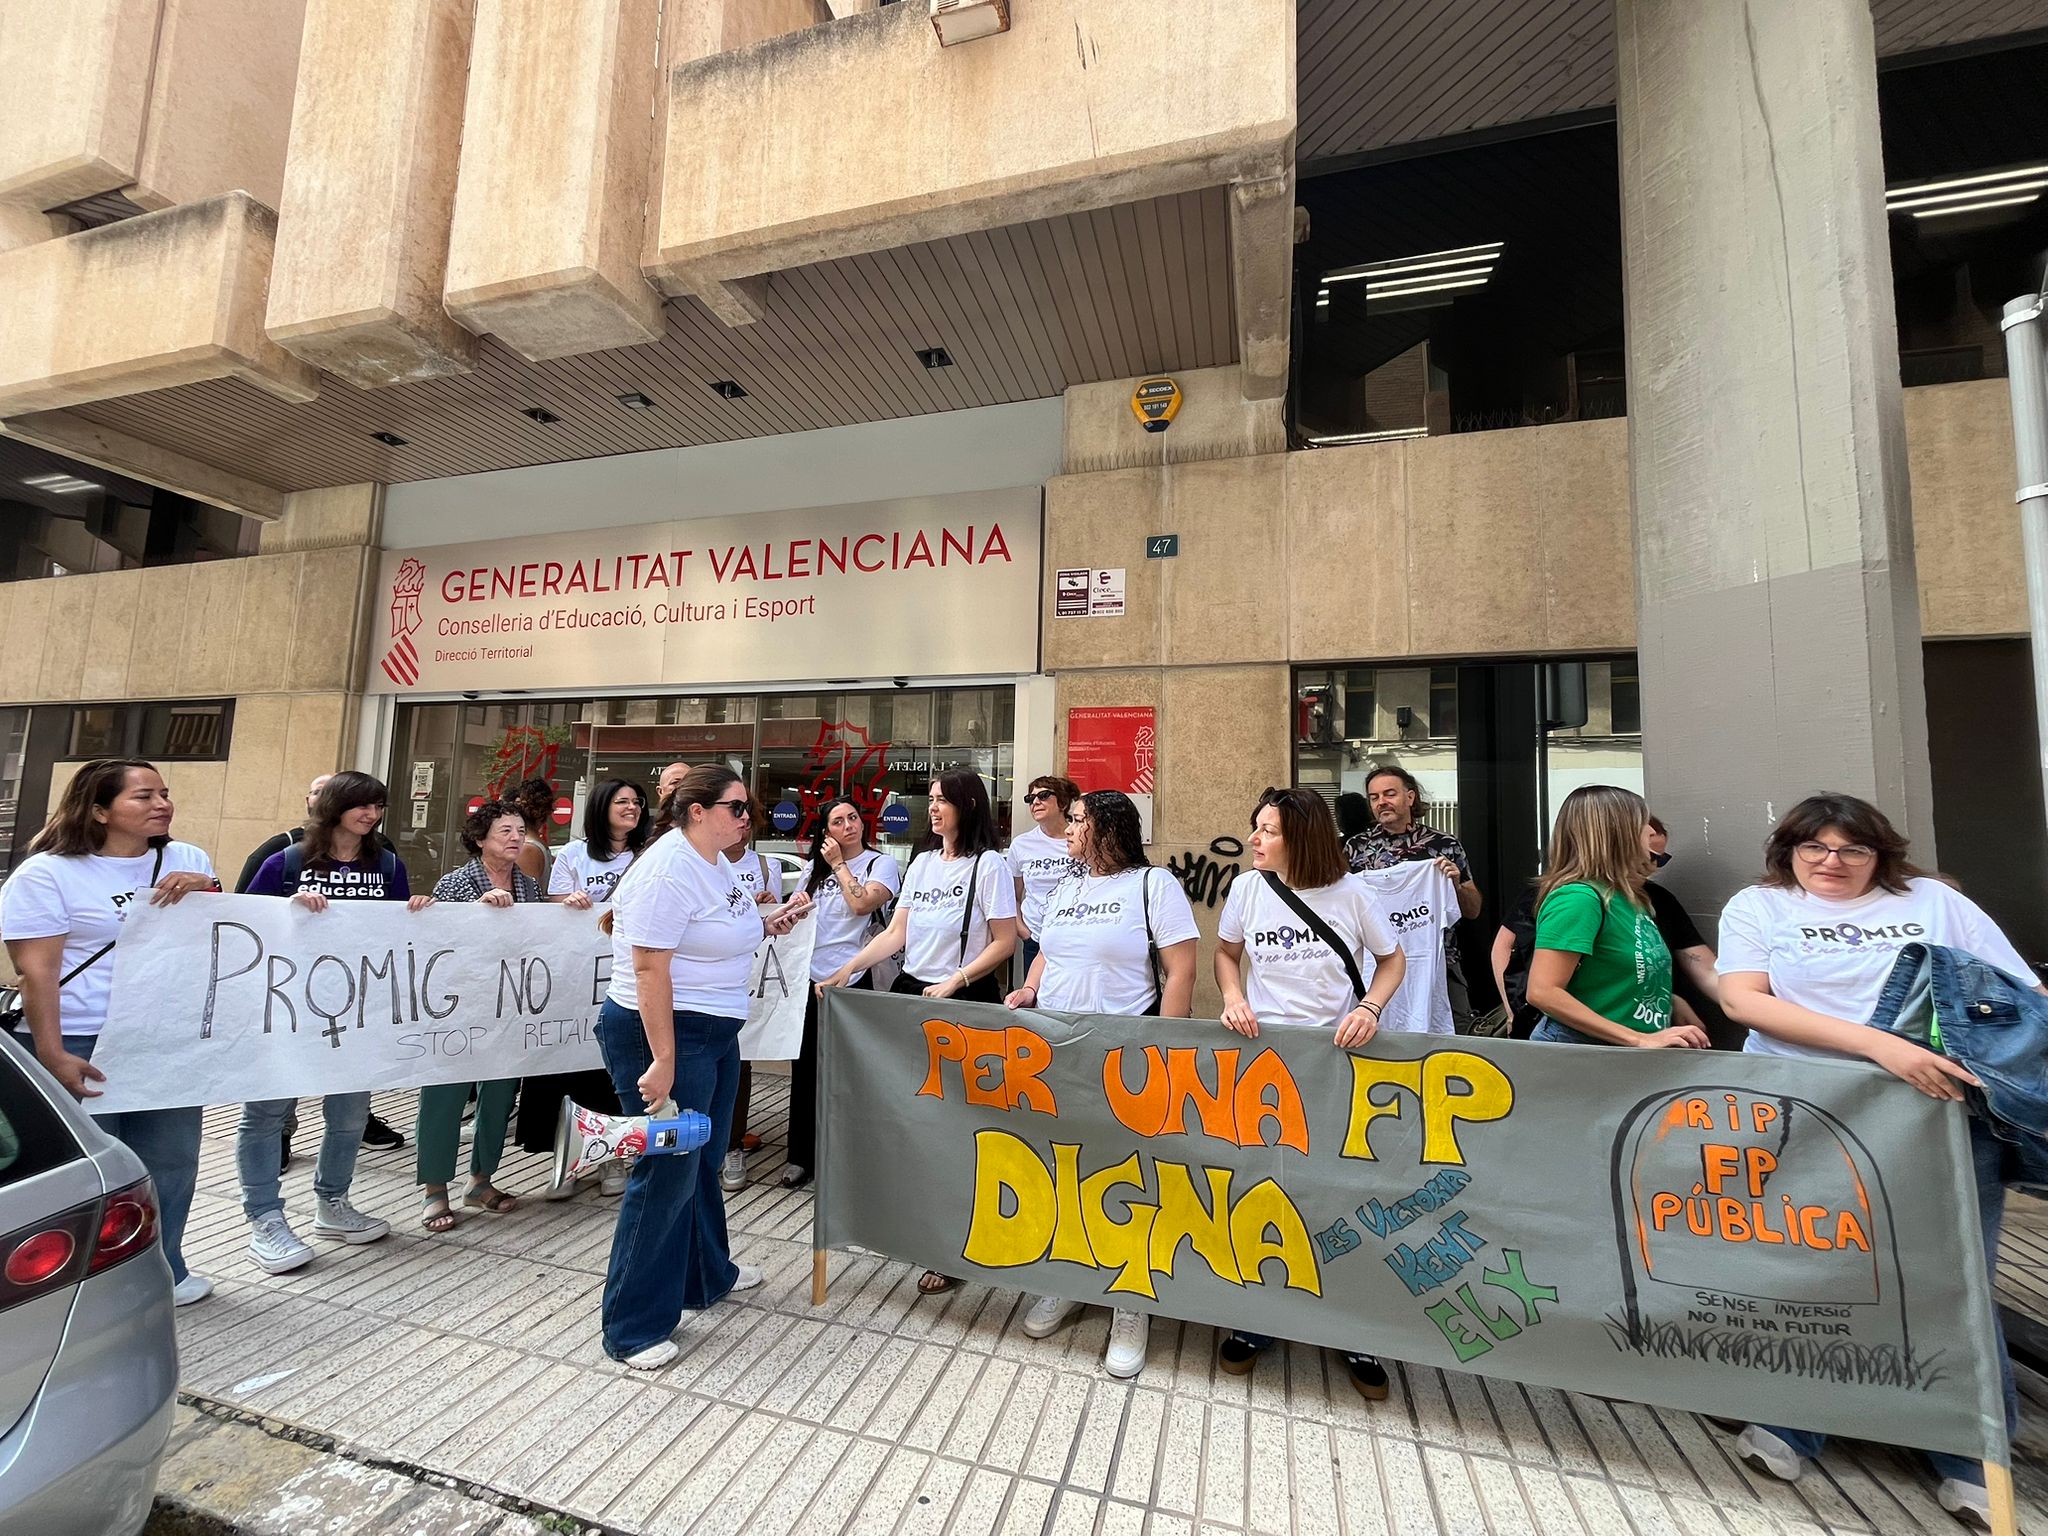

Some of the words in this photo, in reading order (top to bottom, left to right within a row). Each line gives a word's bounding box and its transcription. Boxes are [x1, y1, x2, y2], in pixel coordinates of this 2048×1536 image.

[1152, 539, 1171, 555] 47
[441, 550, 693, 603] GENERALITAT
[708, 523, 1012, 584] VALENCIANA
[438, 613, 533, 636] Conselleria
[653, 600, 726, 624] Cultura
[733, 598, 738, 619] i
[745, 595, 816, 623] Esport
[435, 647, 478, 662] Direcció
[481, 645, 533, 660] Territorial
[1113, 711, 1153, 719] VALENCIANA
[297, 882, 385, 898] educació
[912, 885, 963, 906] PROMIG
[1055, 902, 1121, 919] PROMIG
[1389, 905, 1429, 927] OMIG
[1255, 925, 1321, 949] PROMI
[1800, 923, 1925, 946] PROMIG
[1265, 953, 1283, 963] no
[1284, 952, 1300, 962] es
[1301, 948, 1332, 961] toca
[496, 957, 552, 1018] NO
[396, 1025, 488, 1061] STOP
[915, 1018, 1059, 1117] PER
[1102, 1045, 1309, 1156] UNA
[1338, 1050, 1515, 1166] FP
[1701, 1144, 1778, 1198] FP
[962, 1128, 1322, 1301] DIGNA
[1314, 1217, 1361, 1264] IES
[1355, 1169, 1472, 1240] VICTORIA
[1384, 1210, 1488, 1297] KENT
[1424, 1248, 1560, 1363] ELX
[1695, 1291, 1759, 1313] SENSE
[1688, 1310, 1717, 1324] NO
[1752, 1319, 1778, 1331] HA
[1785, 1321, 1853, 1336] FUTUR
